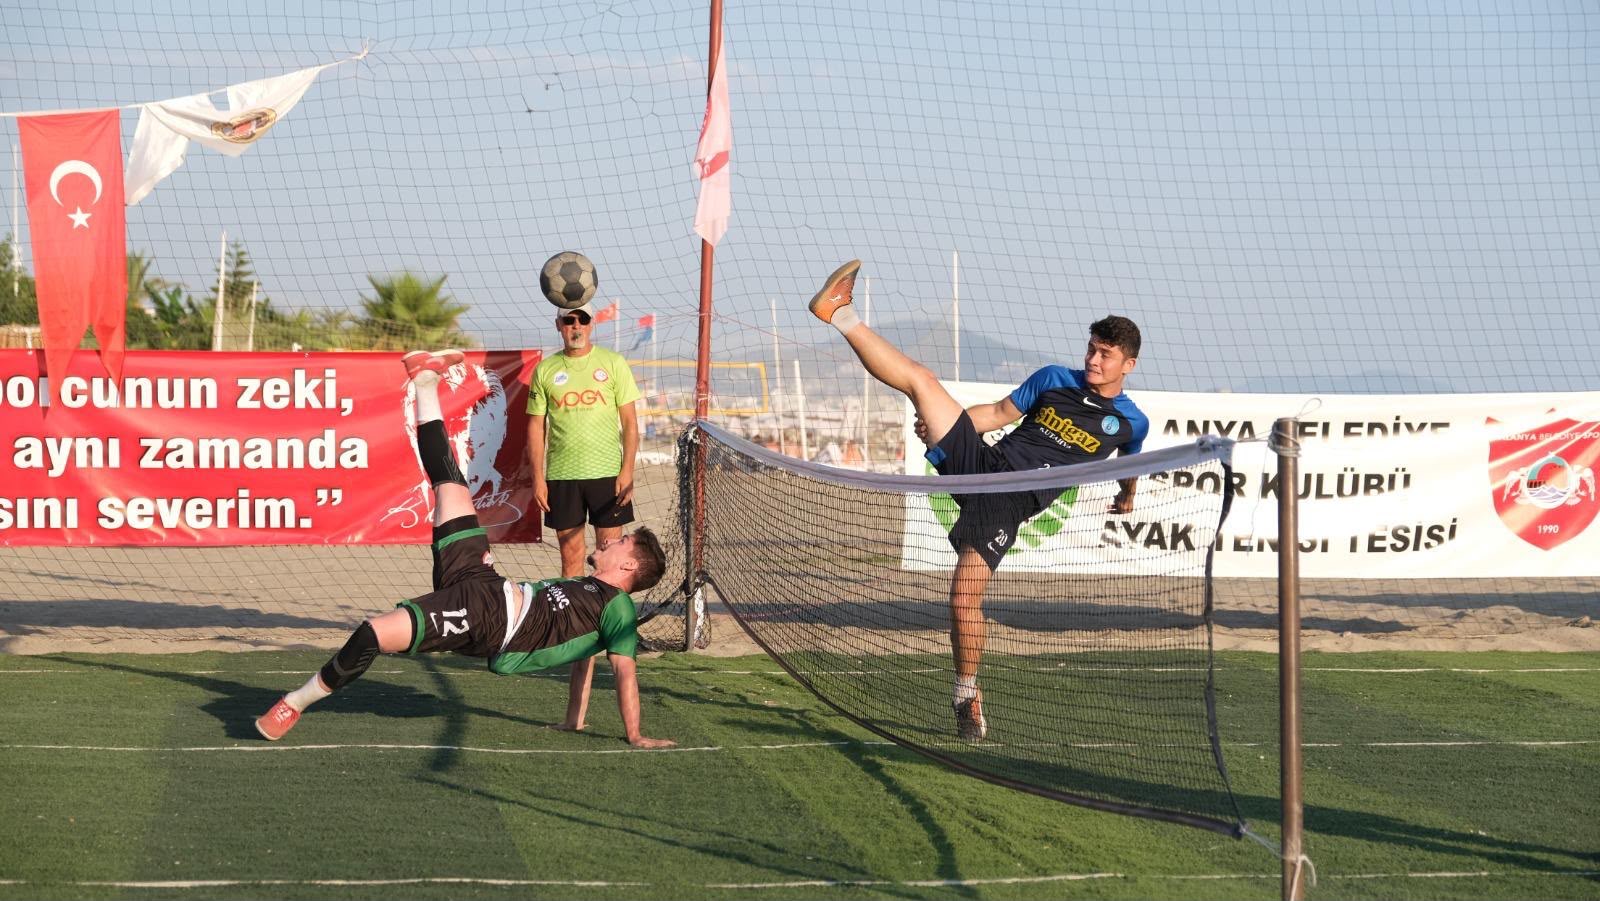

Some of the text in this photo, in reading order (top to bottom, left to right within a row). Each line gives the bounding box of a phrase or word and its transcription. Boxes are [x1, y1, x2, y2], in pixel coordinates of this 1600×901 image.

[0, 368, 353, 416] orcunun zeki,
[1161, 418, 1257, 440] ANYA
[13, 429, 369, 476] aynı zamanda
[1537, 525, 1559, 534] 1990
[442, 607, 470, 637] 12
